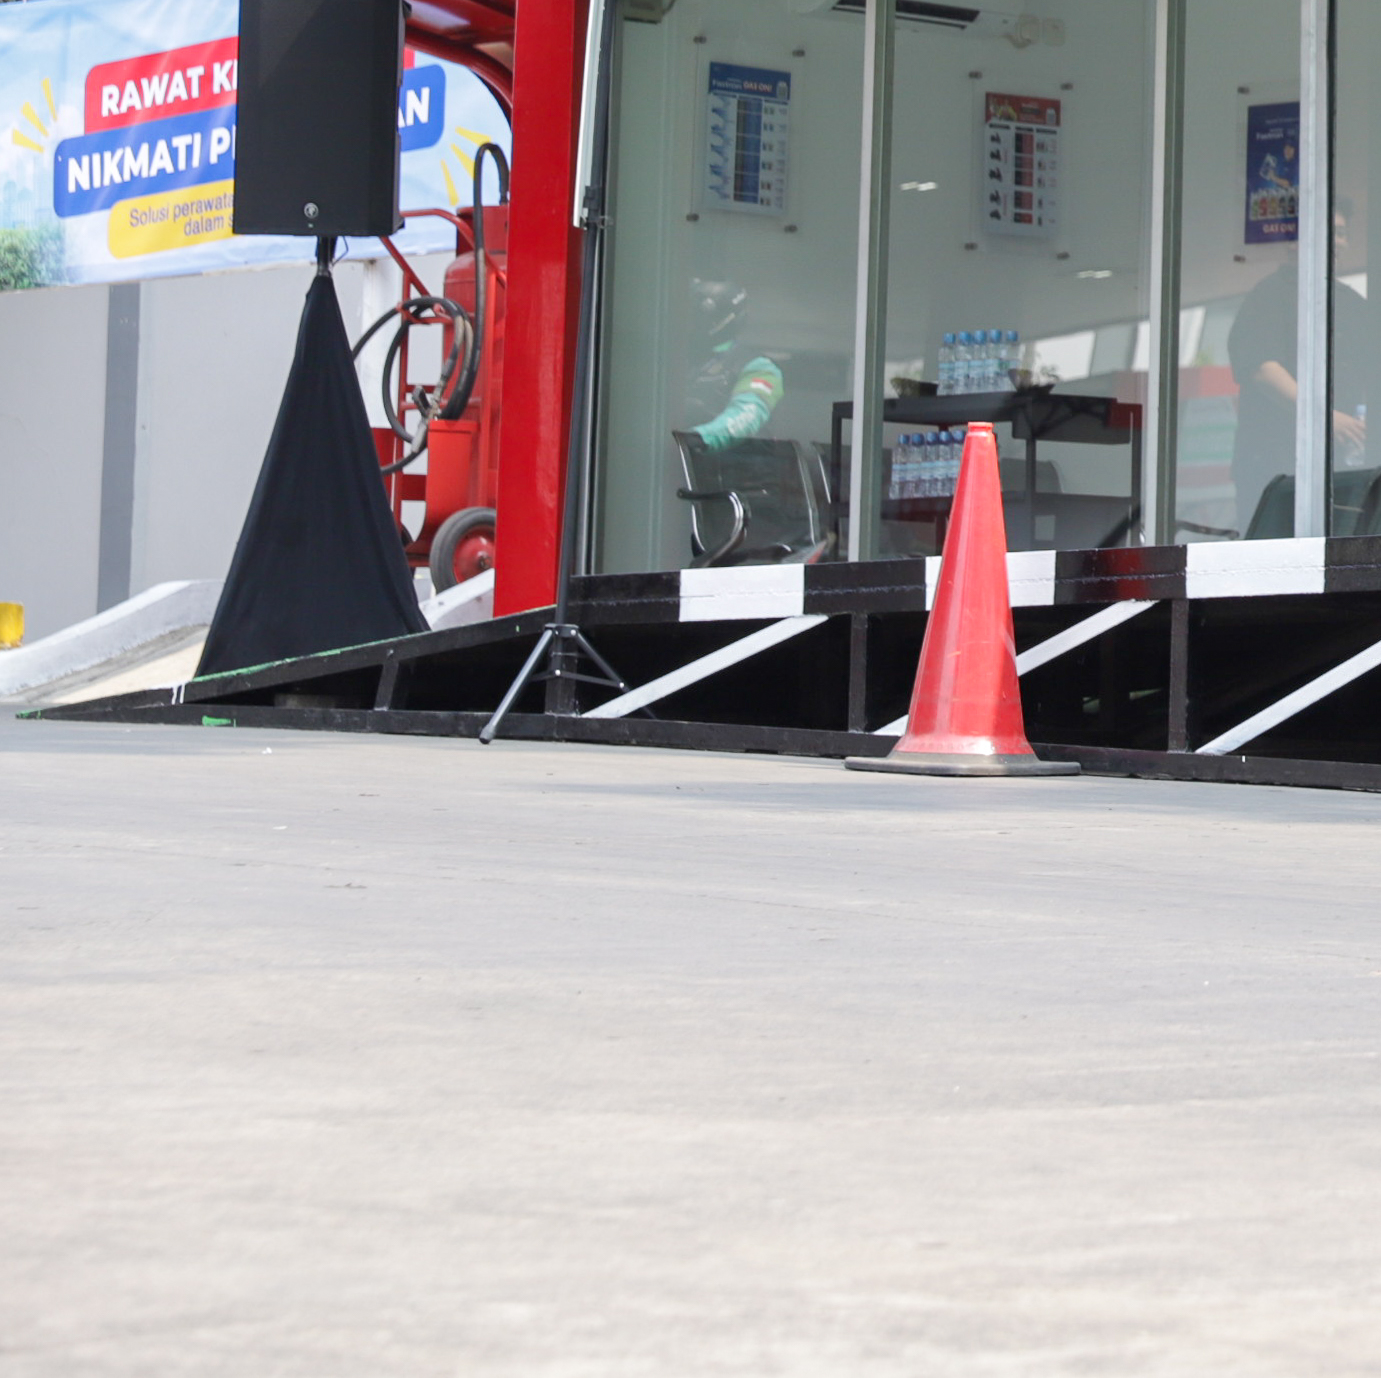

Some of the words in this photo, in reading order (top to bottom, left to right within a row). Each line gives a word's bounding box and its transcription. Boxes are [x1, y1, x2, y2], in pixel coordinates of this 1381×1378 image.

[101, 65, 205, 118] RAWAT
[67, 133, 202, 194] NIKMATI
[209, 124, 237, 165] P
[130, 202, 169, 228] Solusi
[184, 215, 225, 237] dalam
